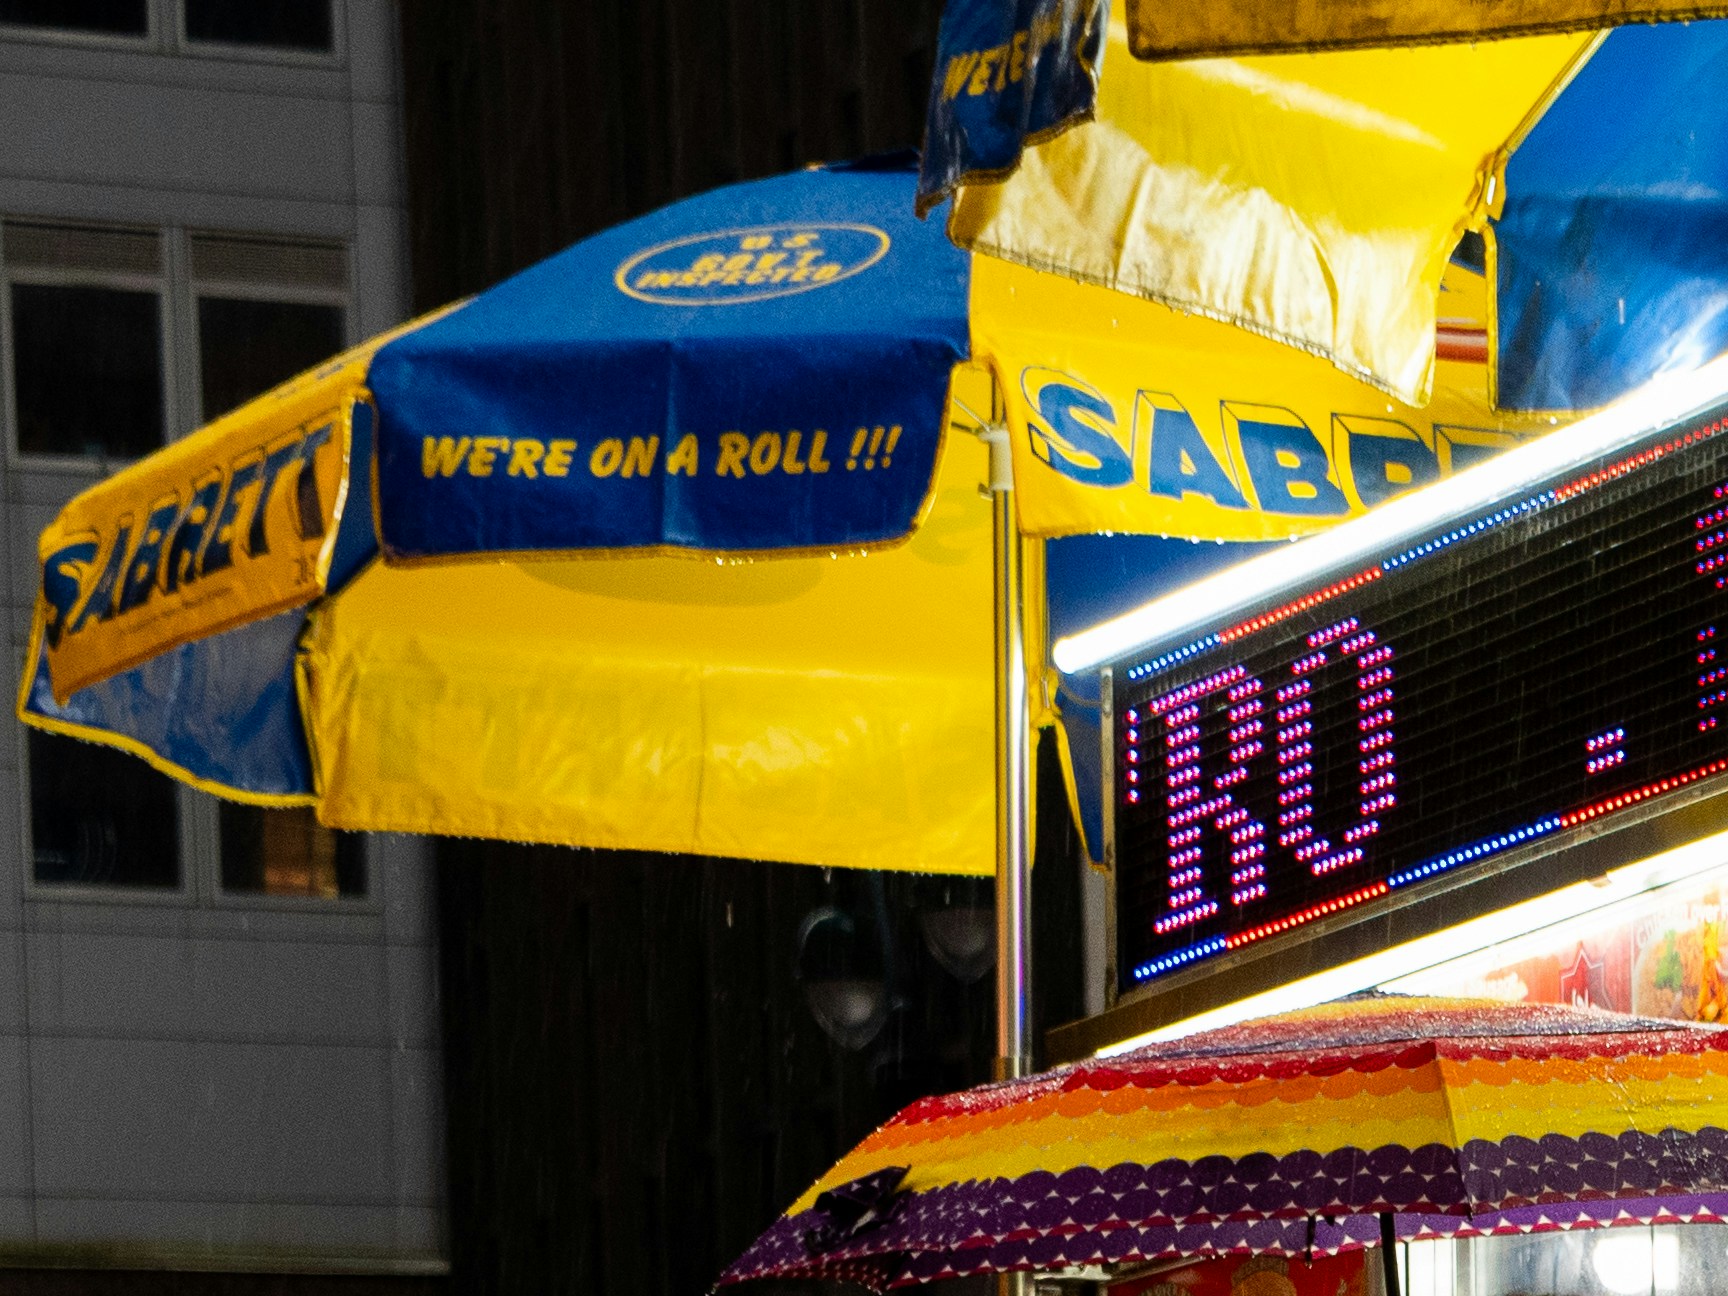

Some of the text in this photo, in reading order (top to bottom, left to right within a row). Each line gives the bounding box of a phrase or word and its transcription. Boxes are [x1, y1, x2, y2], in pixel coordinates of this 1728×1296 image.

[43, 405, 341, 650] SABRETT
[420, 425, 903, 480] WE'RE ON A ROLL !!!
